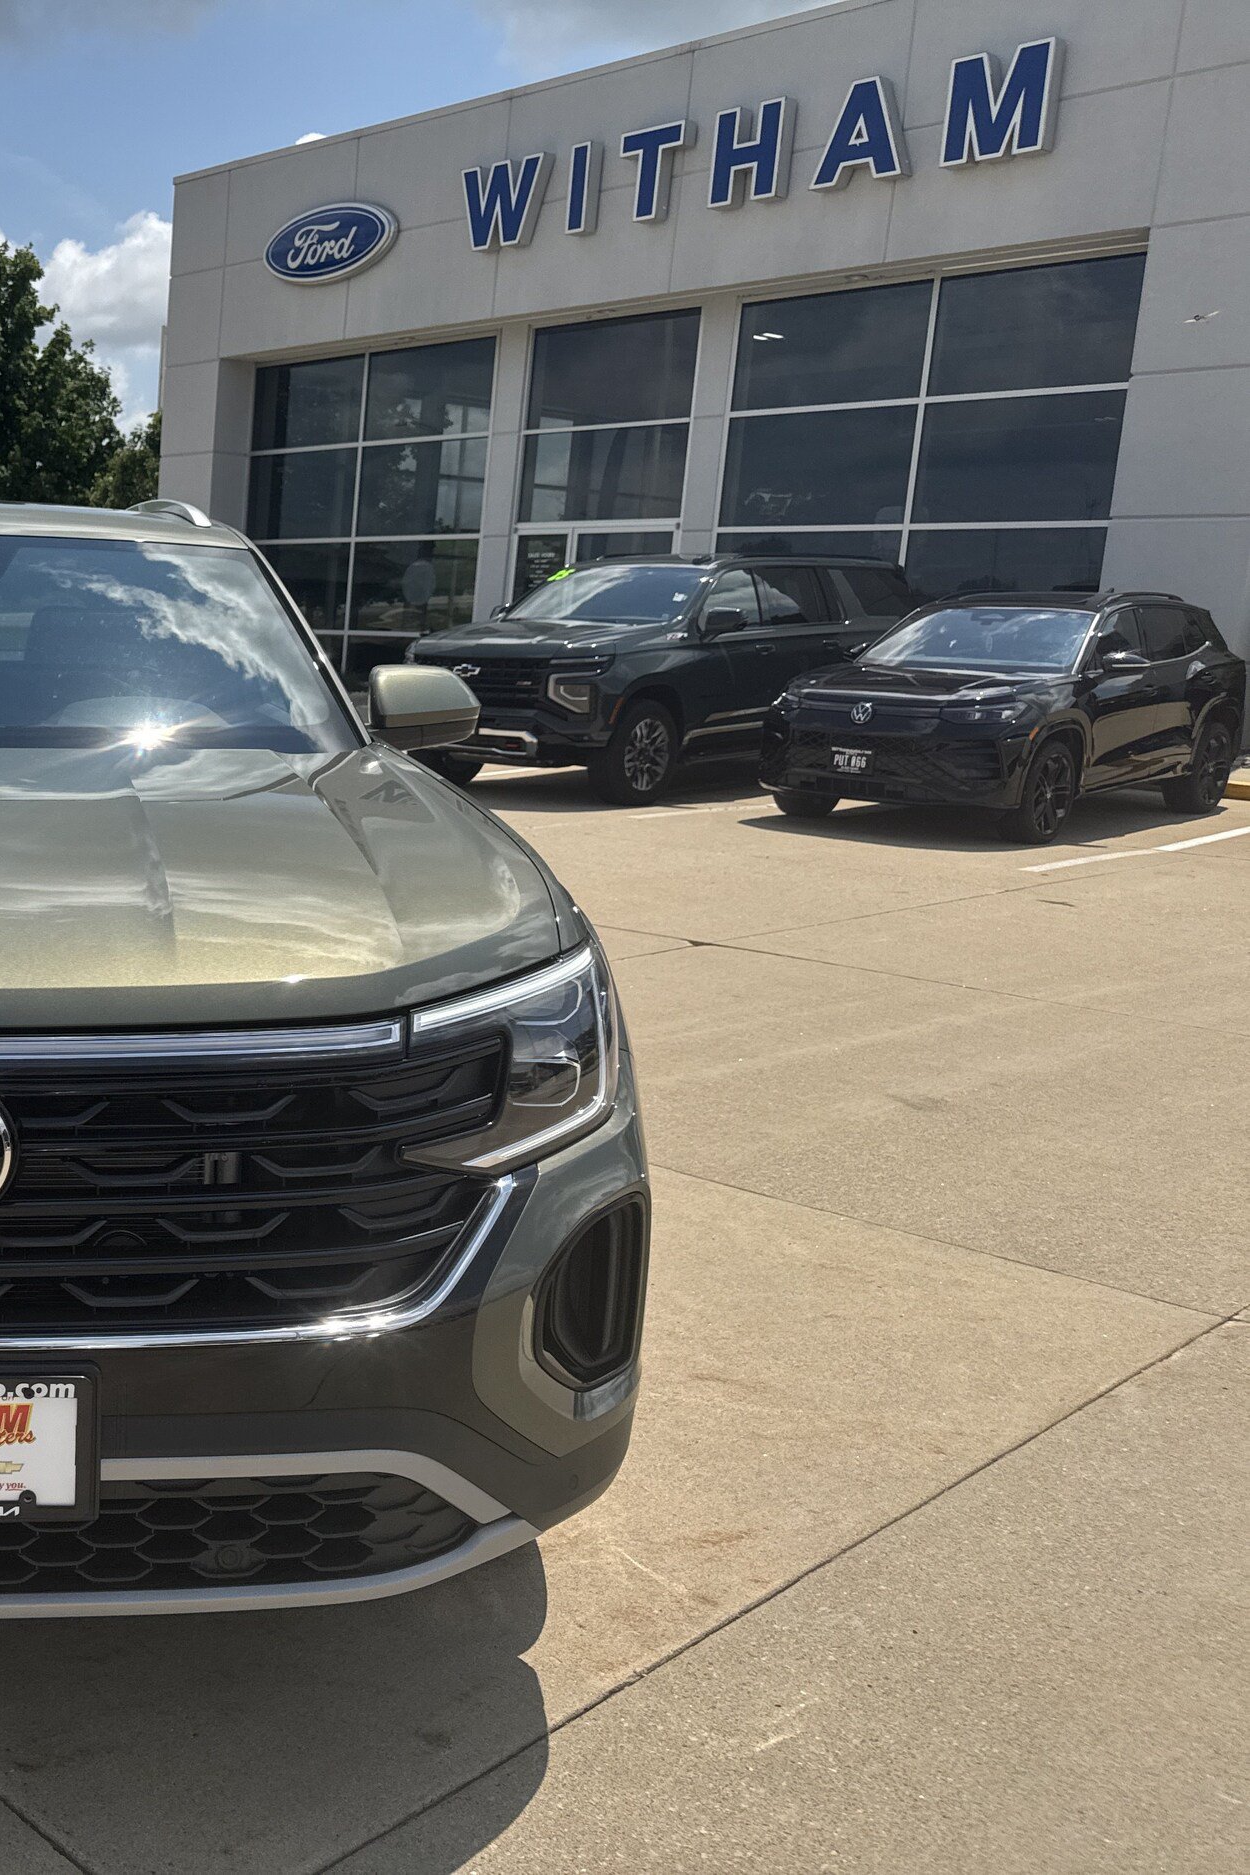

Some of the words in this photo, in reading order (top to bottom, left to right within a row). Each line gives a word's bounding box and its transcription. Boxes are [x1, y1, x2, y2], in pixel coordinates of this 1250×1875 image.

[461, 36, 1062, 251] WITHAM
[286, 221, 358, 269] Ford
[5, 1481, 27, 1492] you.
